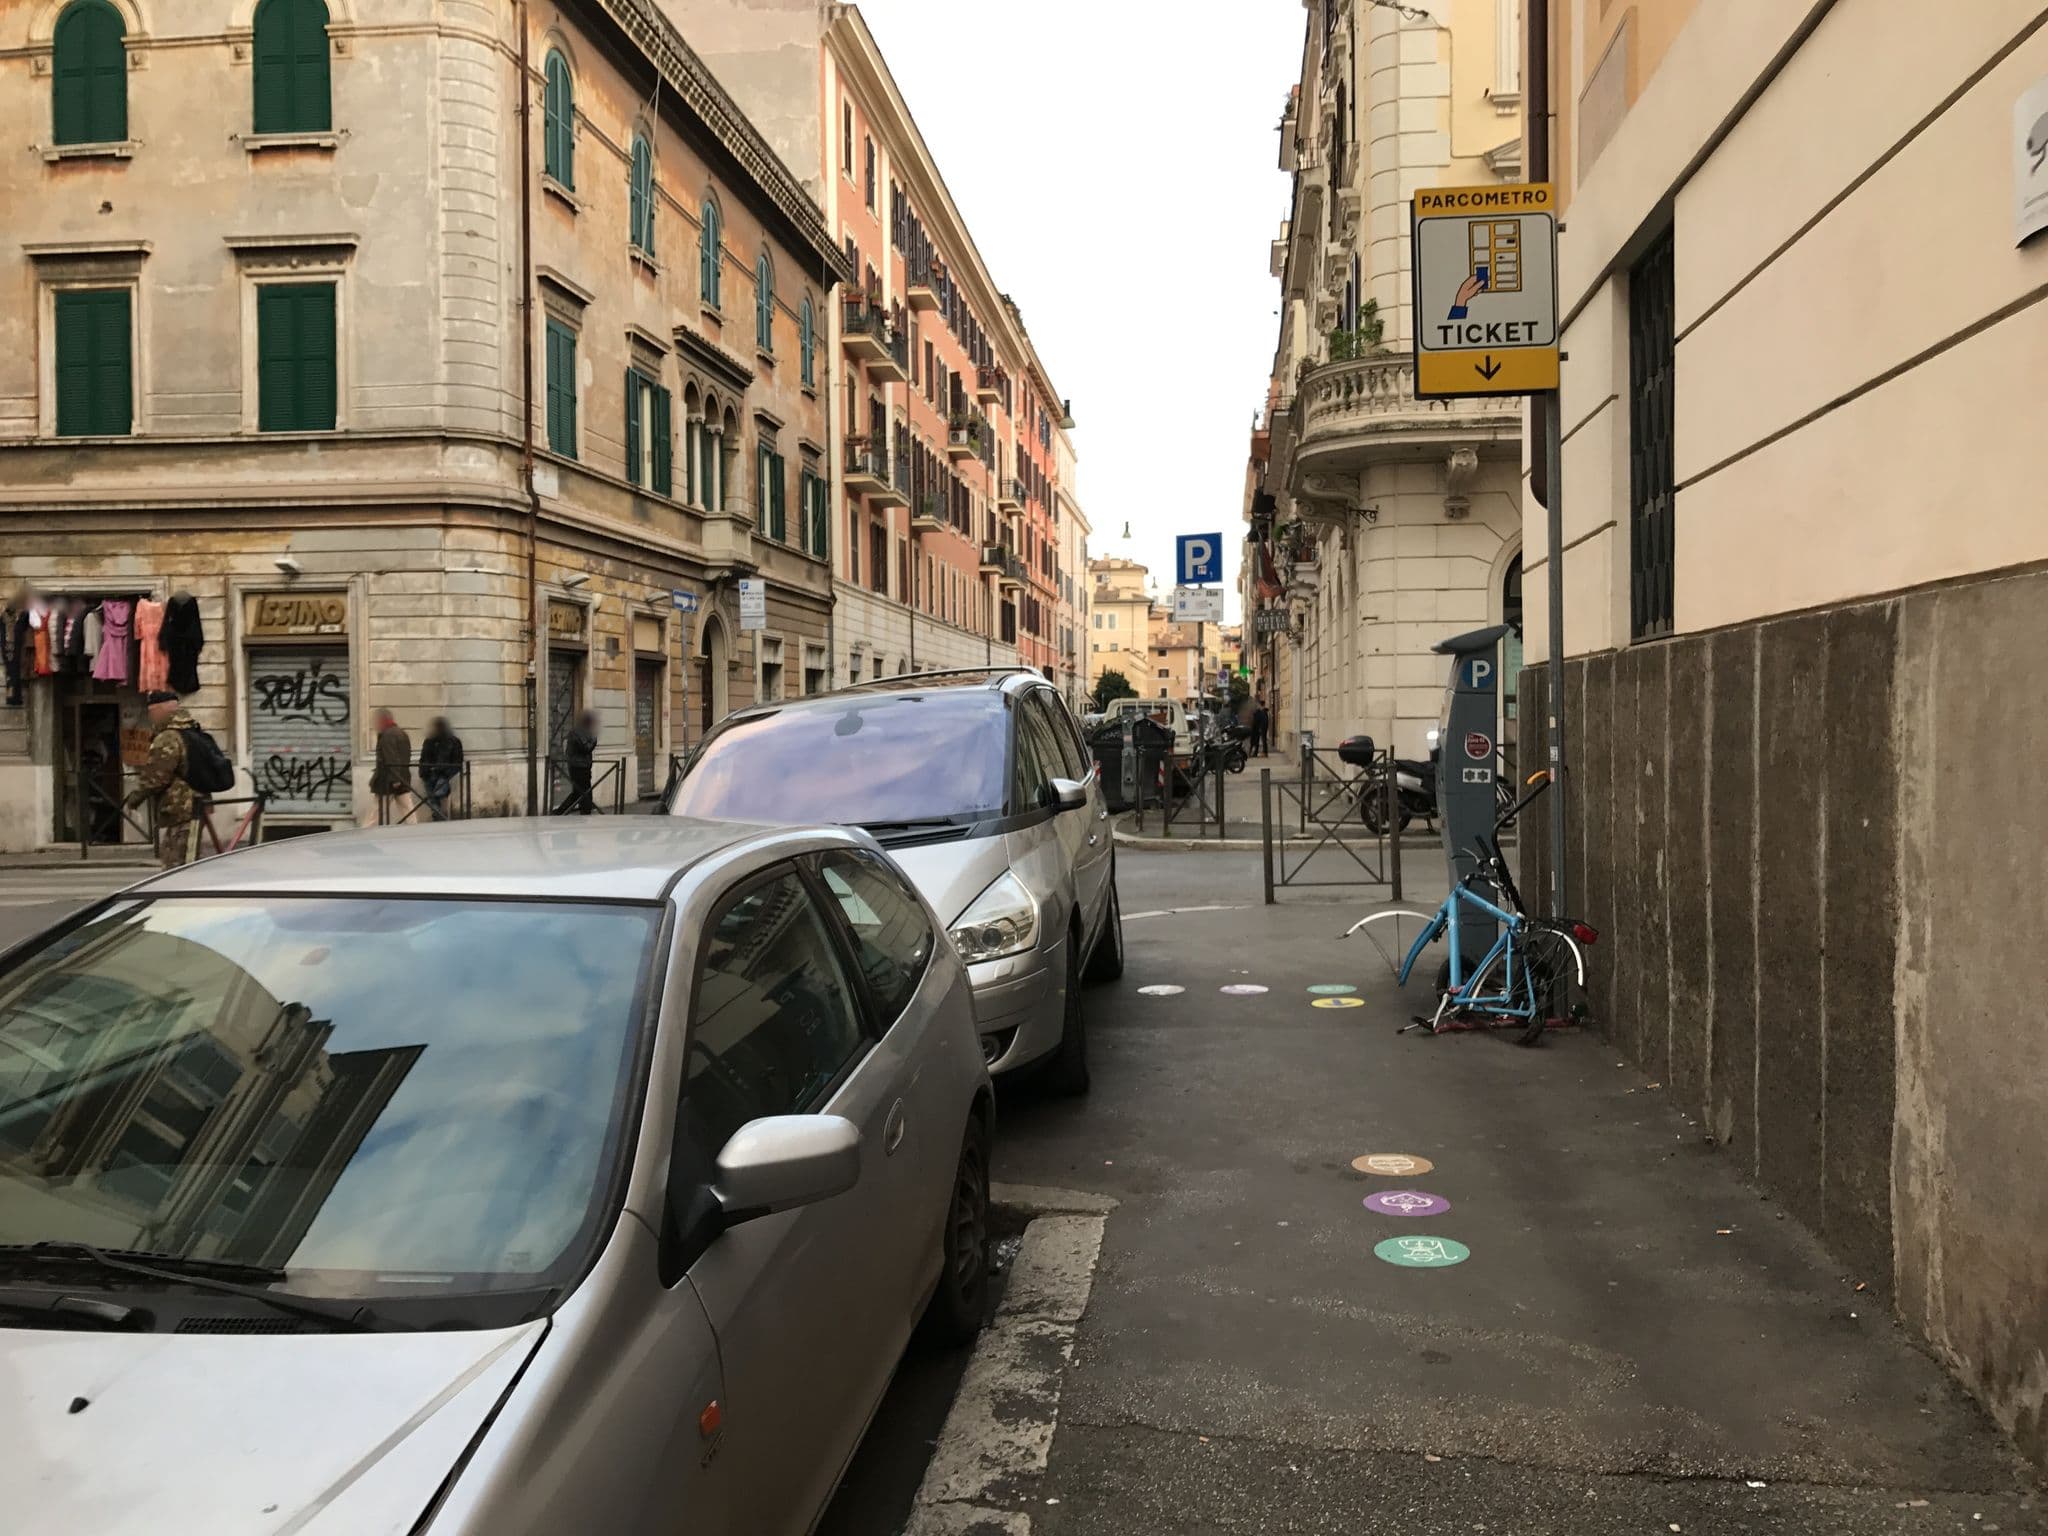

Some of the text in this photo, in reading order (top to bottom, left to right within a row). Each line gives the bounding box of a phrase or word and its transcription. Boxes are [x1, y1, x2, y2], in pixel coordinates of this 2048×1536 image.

[1421, 190, 1548, 209] PARCOMETRO
[1437, 321, 1539, 345] TICKET
[1185, 539, 1212, 579] P
[1471, 659, 1491, 688] P
